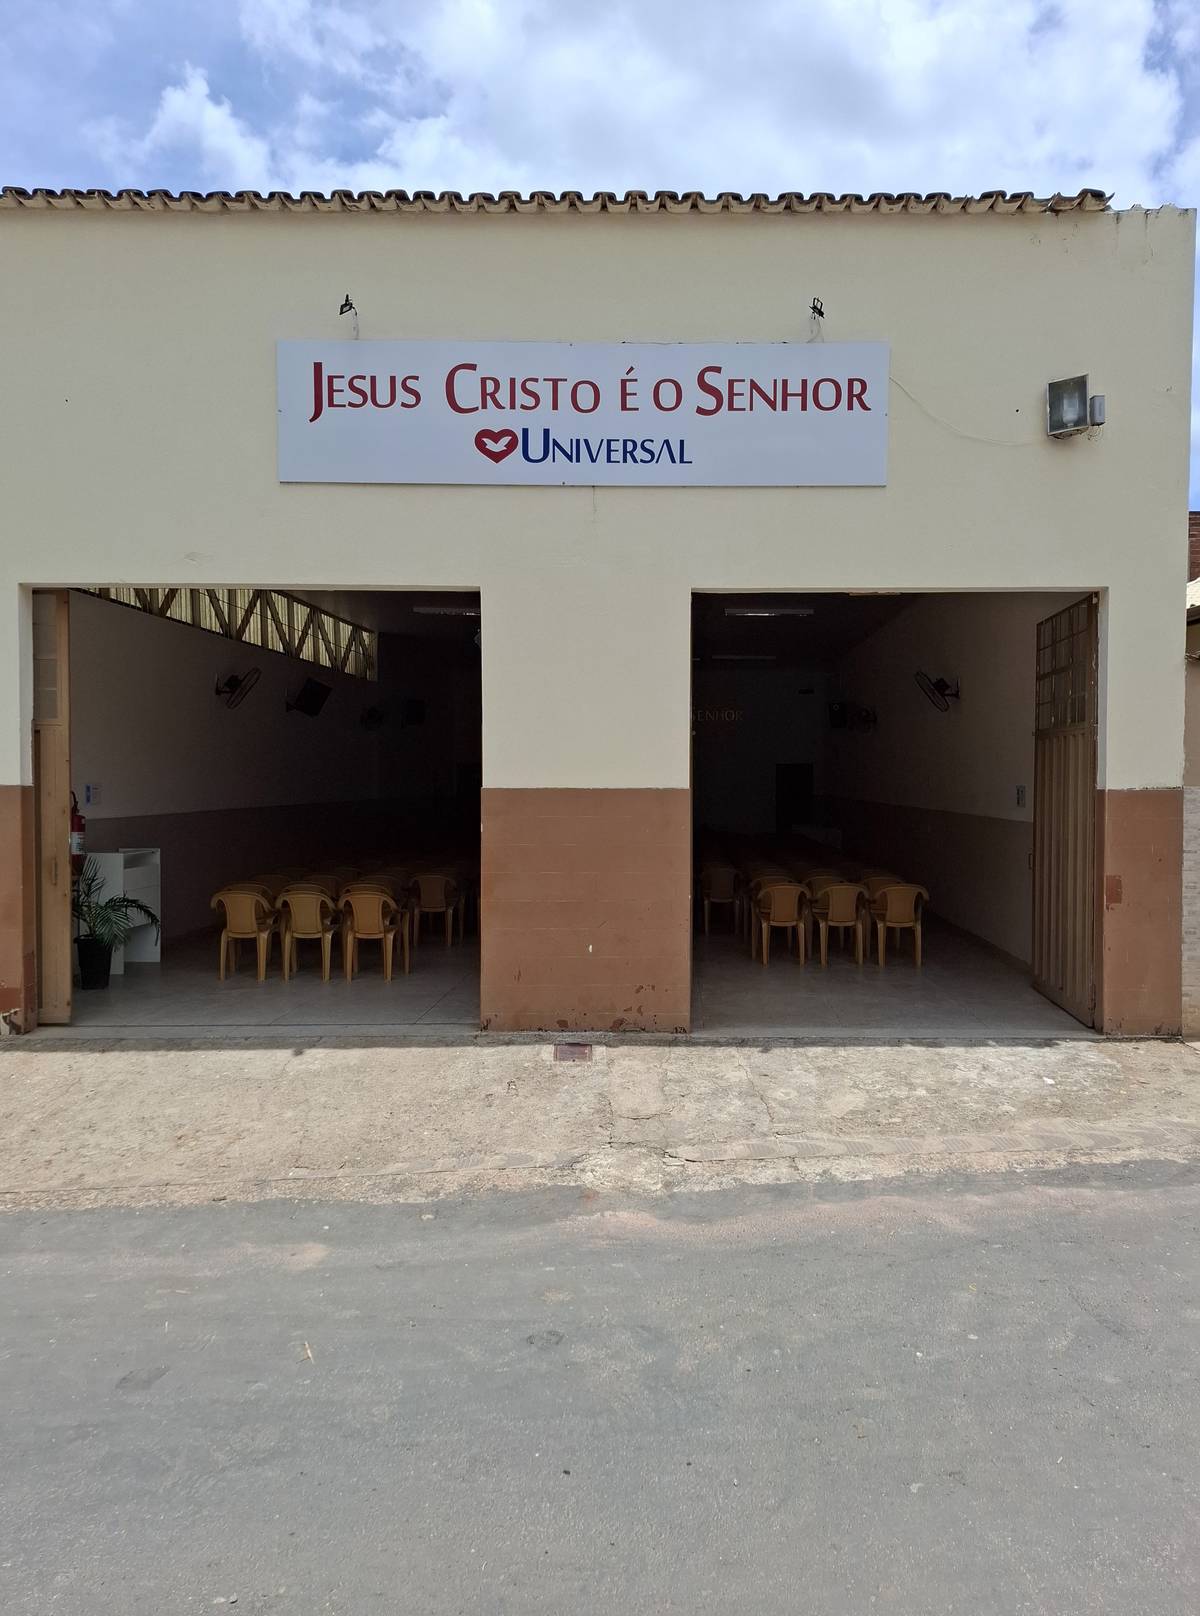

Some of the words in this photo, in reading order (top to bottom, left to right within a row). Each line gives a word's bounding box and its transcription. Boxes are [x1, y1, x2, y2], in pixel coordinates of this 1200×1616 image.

[309, 362, 422, 422] JESUS
[446, 363, 601, 414] CRISTO
[621, 366, 641, 411] É
[653, 379, 683, 412] O
[696, 366, 872, 416] SENHOR
[522, 428, 693, 465] UNIVERSAL
